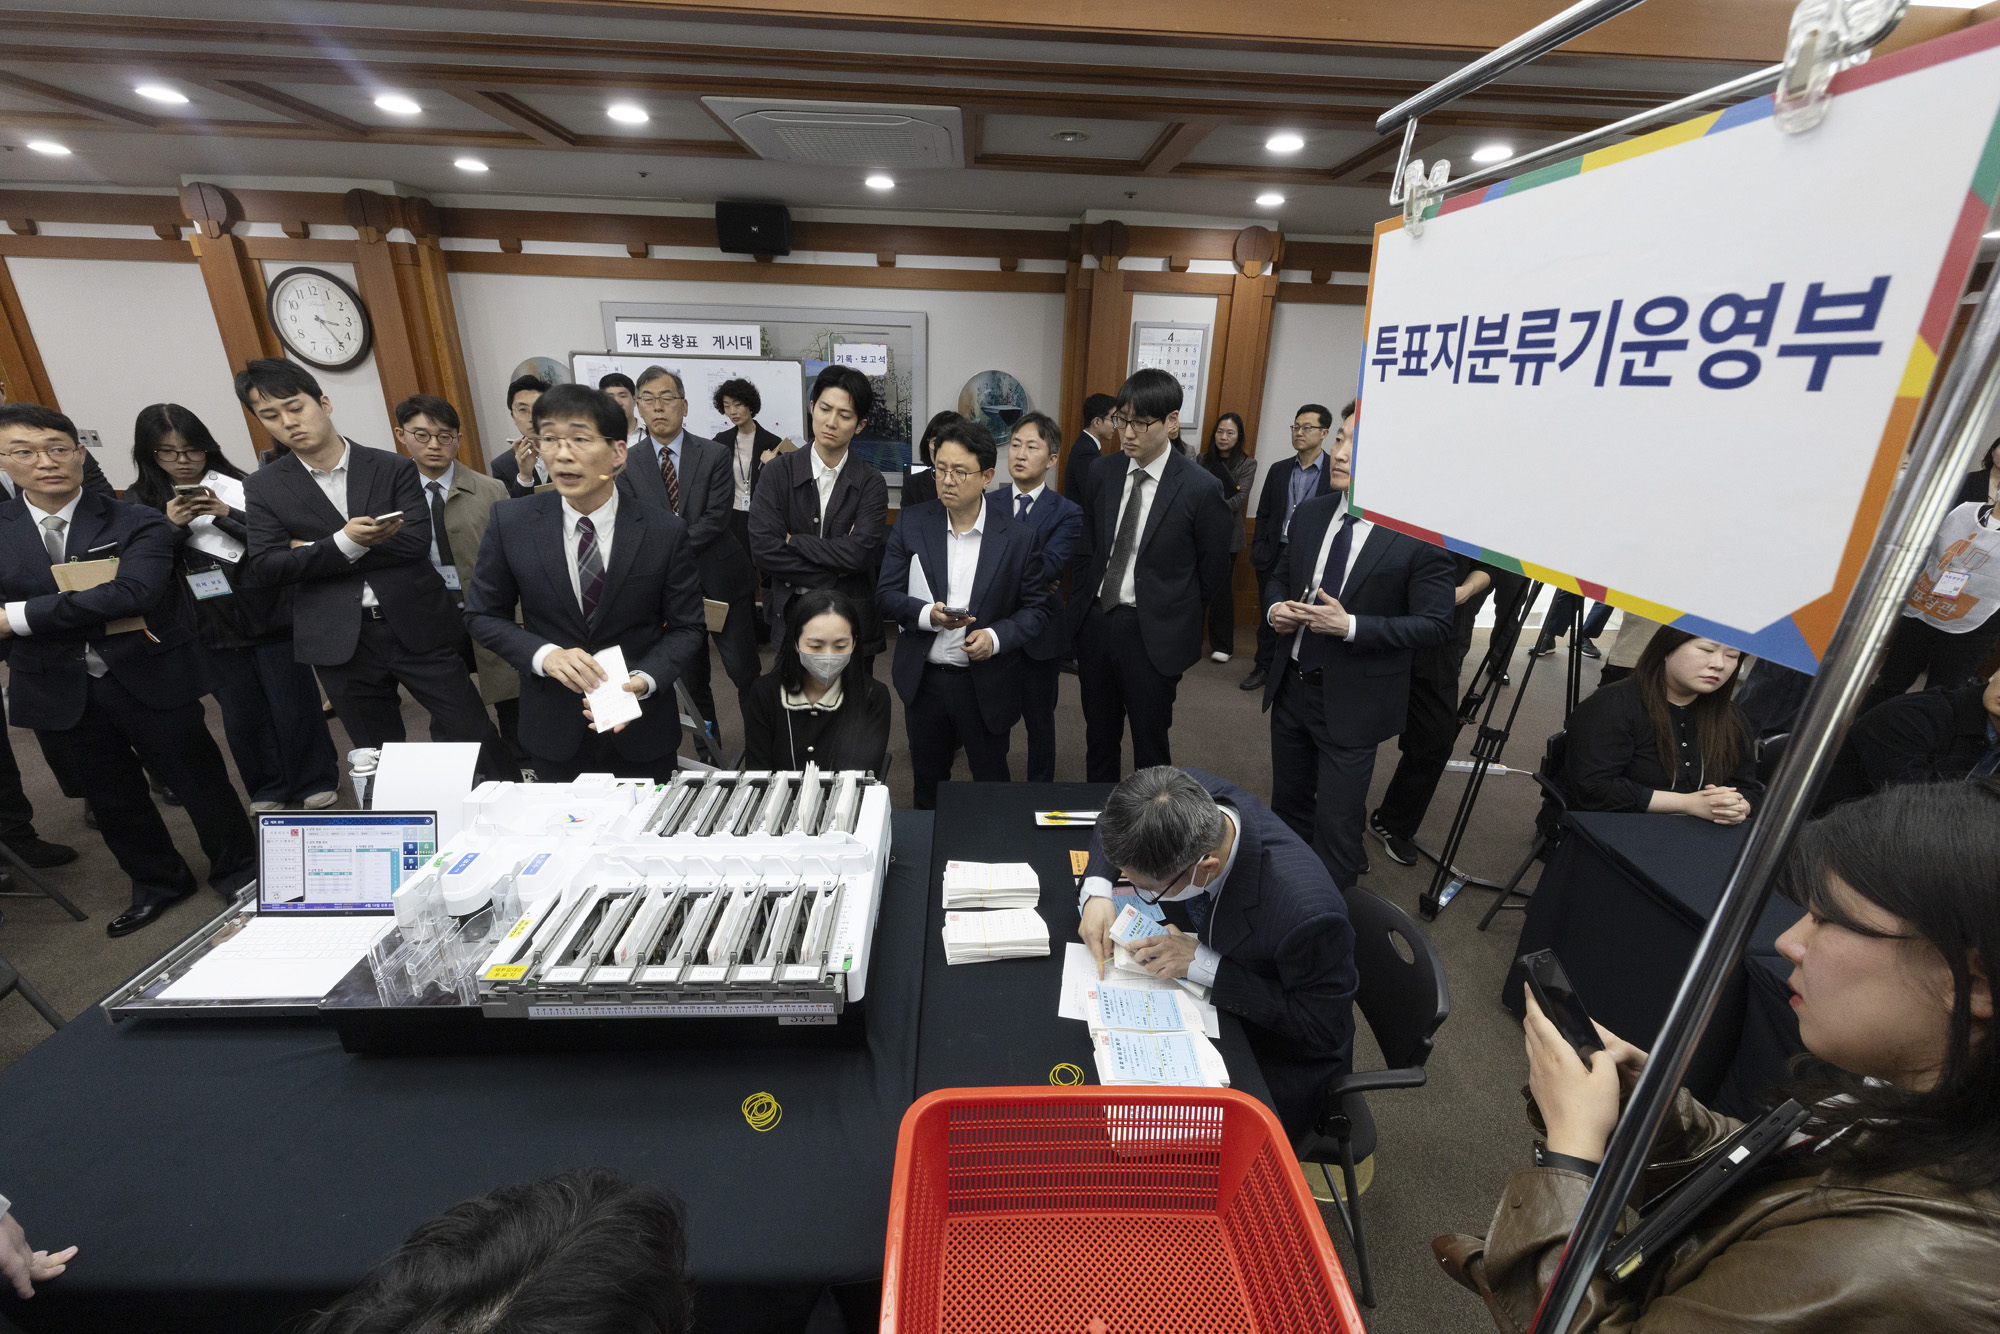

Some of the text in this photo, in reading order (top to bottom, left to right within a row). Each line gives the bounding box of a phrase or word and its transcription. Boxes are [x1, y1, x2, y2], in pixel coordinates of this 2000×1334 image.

[295, 289, 304, 299] 11
[308, 285, 318, 296] 12
[325, 290, 330, 300] 1
[288, 300, 299, 310] 10
[337, 301, 344, 311] 2
[290, 315, 297, 324] 9
[345, 317, 352, 327] 3
[298, 329, 305, 339] 8
[344, 332, 351, 341] 4
[1167, 332, 1174, 342] 4
[1371, 274, 1893, 392] 투표지분류기운영부
[310, 341, 316, 350] 7
[338, 341, 345, 351] 5
[626, 332, 753, 350] 개표 상황표 게시대
[325, 345, 332, 355] 6
[1911, 590, 1957, 617] 표참관
